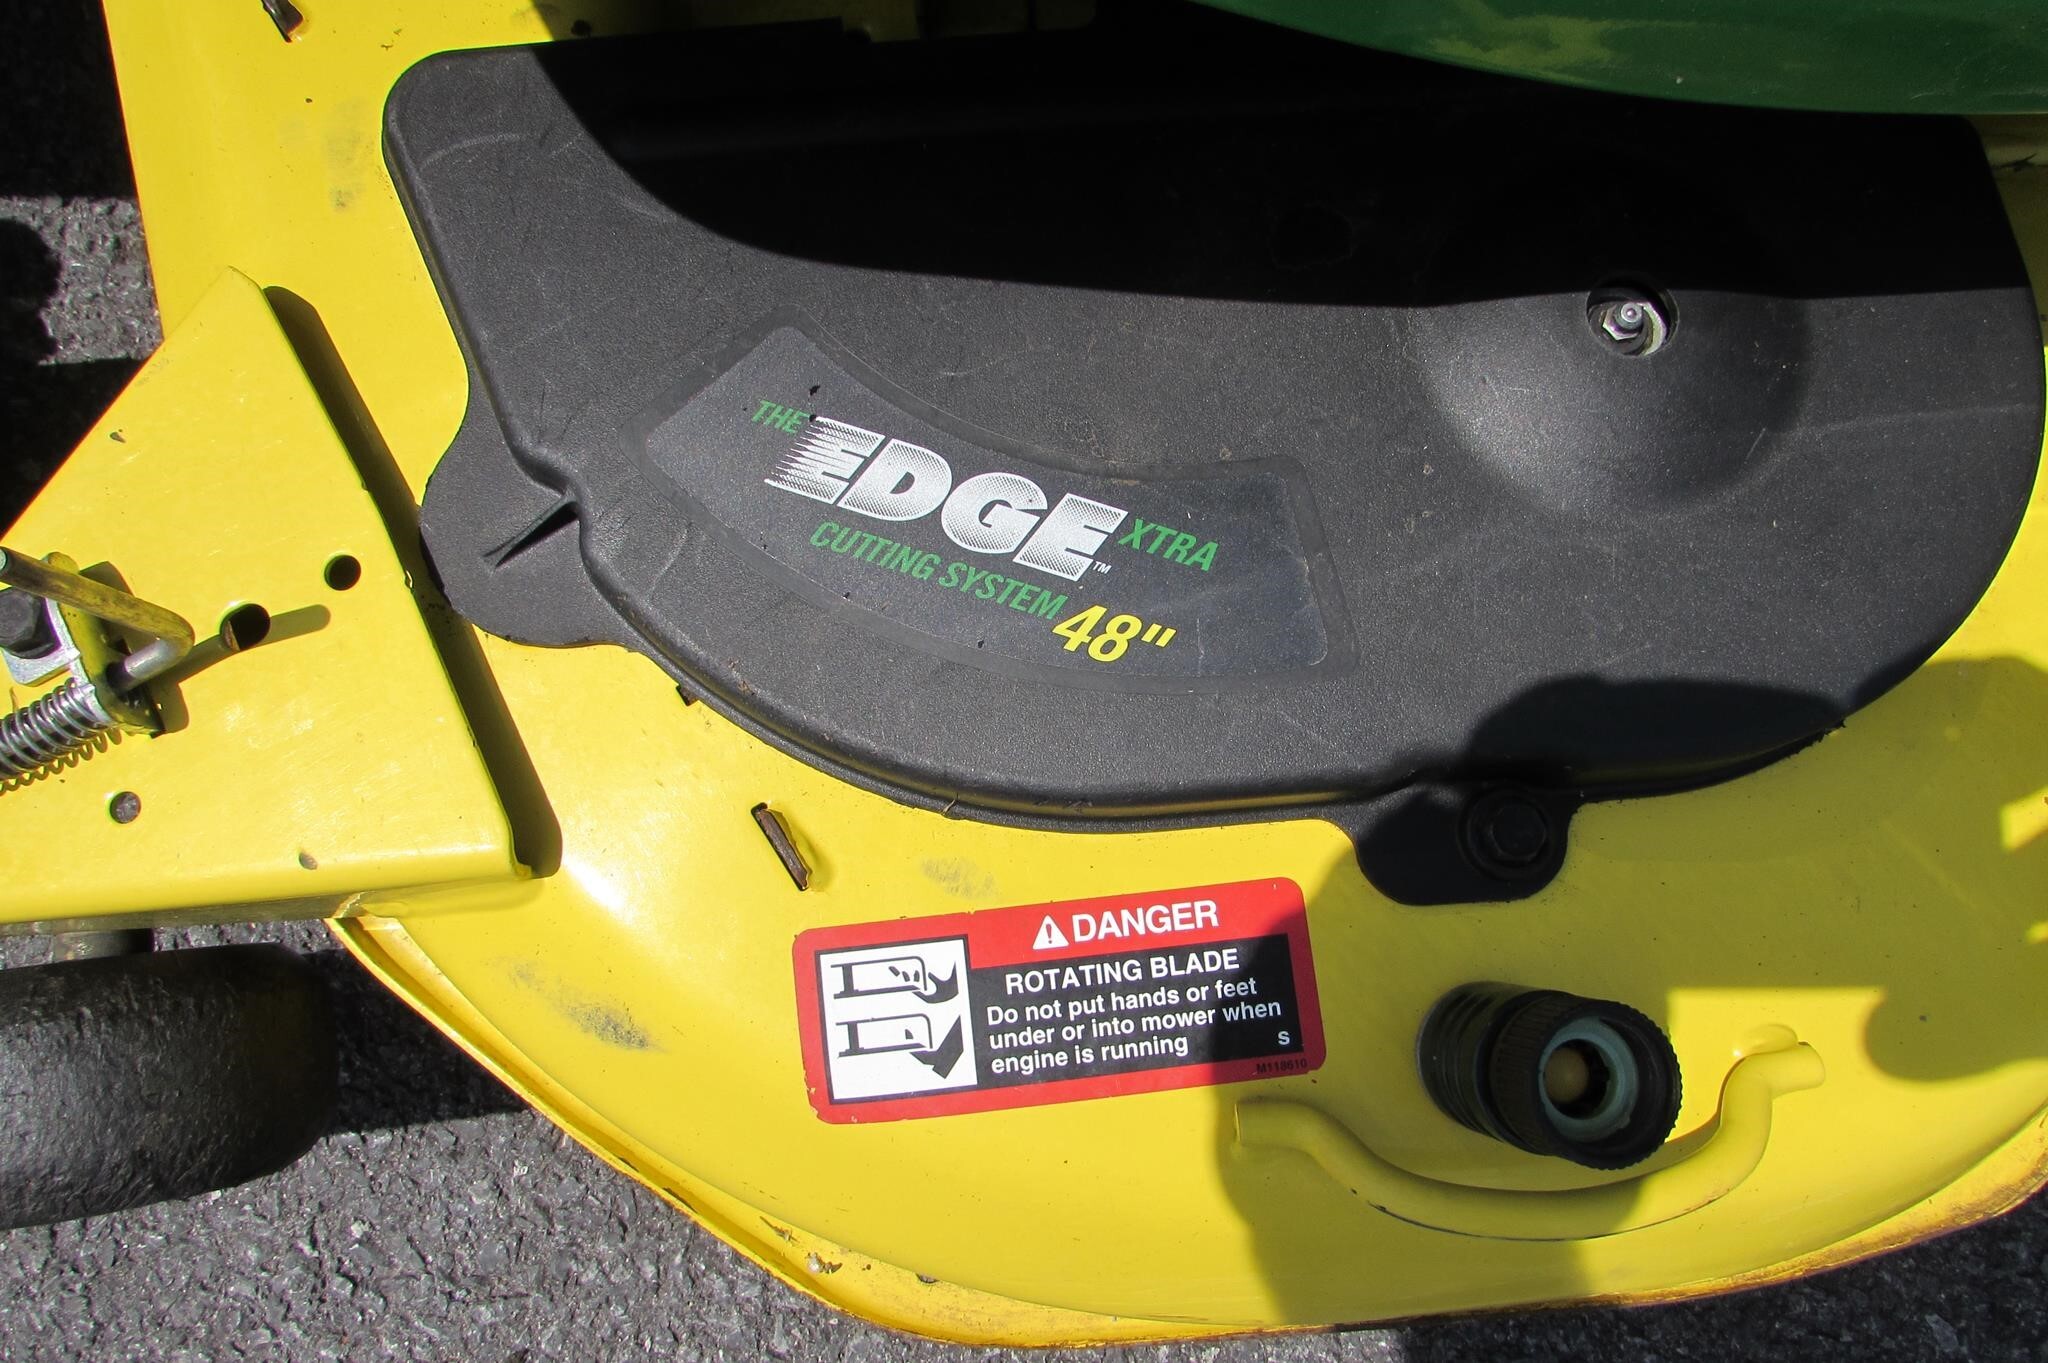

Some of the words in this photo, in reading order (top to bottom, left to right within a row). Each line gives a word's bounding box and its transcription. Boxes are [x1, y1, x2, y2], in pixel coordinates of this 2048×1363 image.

[750, 400, 811, 435] THE
[764, 416, 1128, 582] EDGE
[1118, 518, 1221, 572] XTRA
[809, 521, 941, 580] CUTTING
[938, 562, 1069, 620] SYSTEM
[1051, 604, 1177, 662] 48"
[1072, 900, 1219, 942] DANGER
[1005, 959, 1143, 995] ROTATING
[1150, 948, 1240, 979] BLADE
[986, 1005, 1018, 1025] Do
[1025, 1001, 1062, 1021] not
[1069, 993, 1105, 1021] put
[1111, 986, 1180, 1010] hands
[1186, 983, 1209, 1001] or
[1214, 977, 1257, 999] feet
[989, 1024, 1055, 1050] under
[1061, 1022, 1084, 1041] or
[1091, 1017, 1135, 1038] into
[1141, 1007, 1216, 1032] mower
[1222, 1001, 1282, 1022] when
[991, 1048, 1068, 1075] engine
[1074, 1044, 1094, 1064] is
[1101, 1036, 1188, 1061] running
